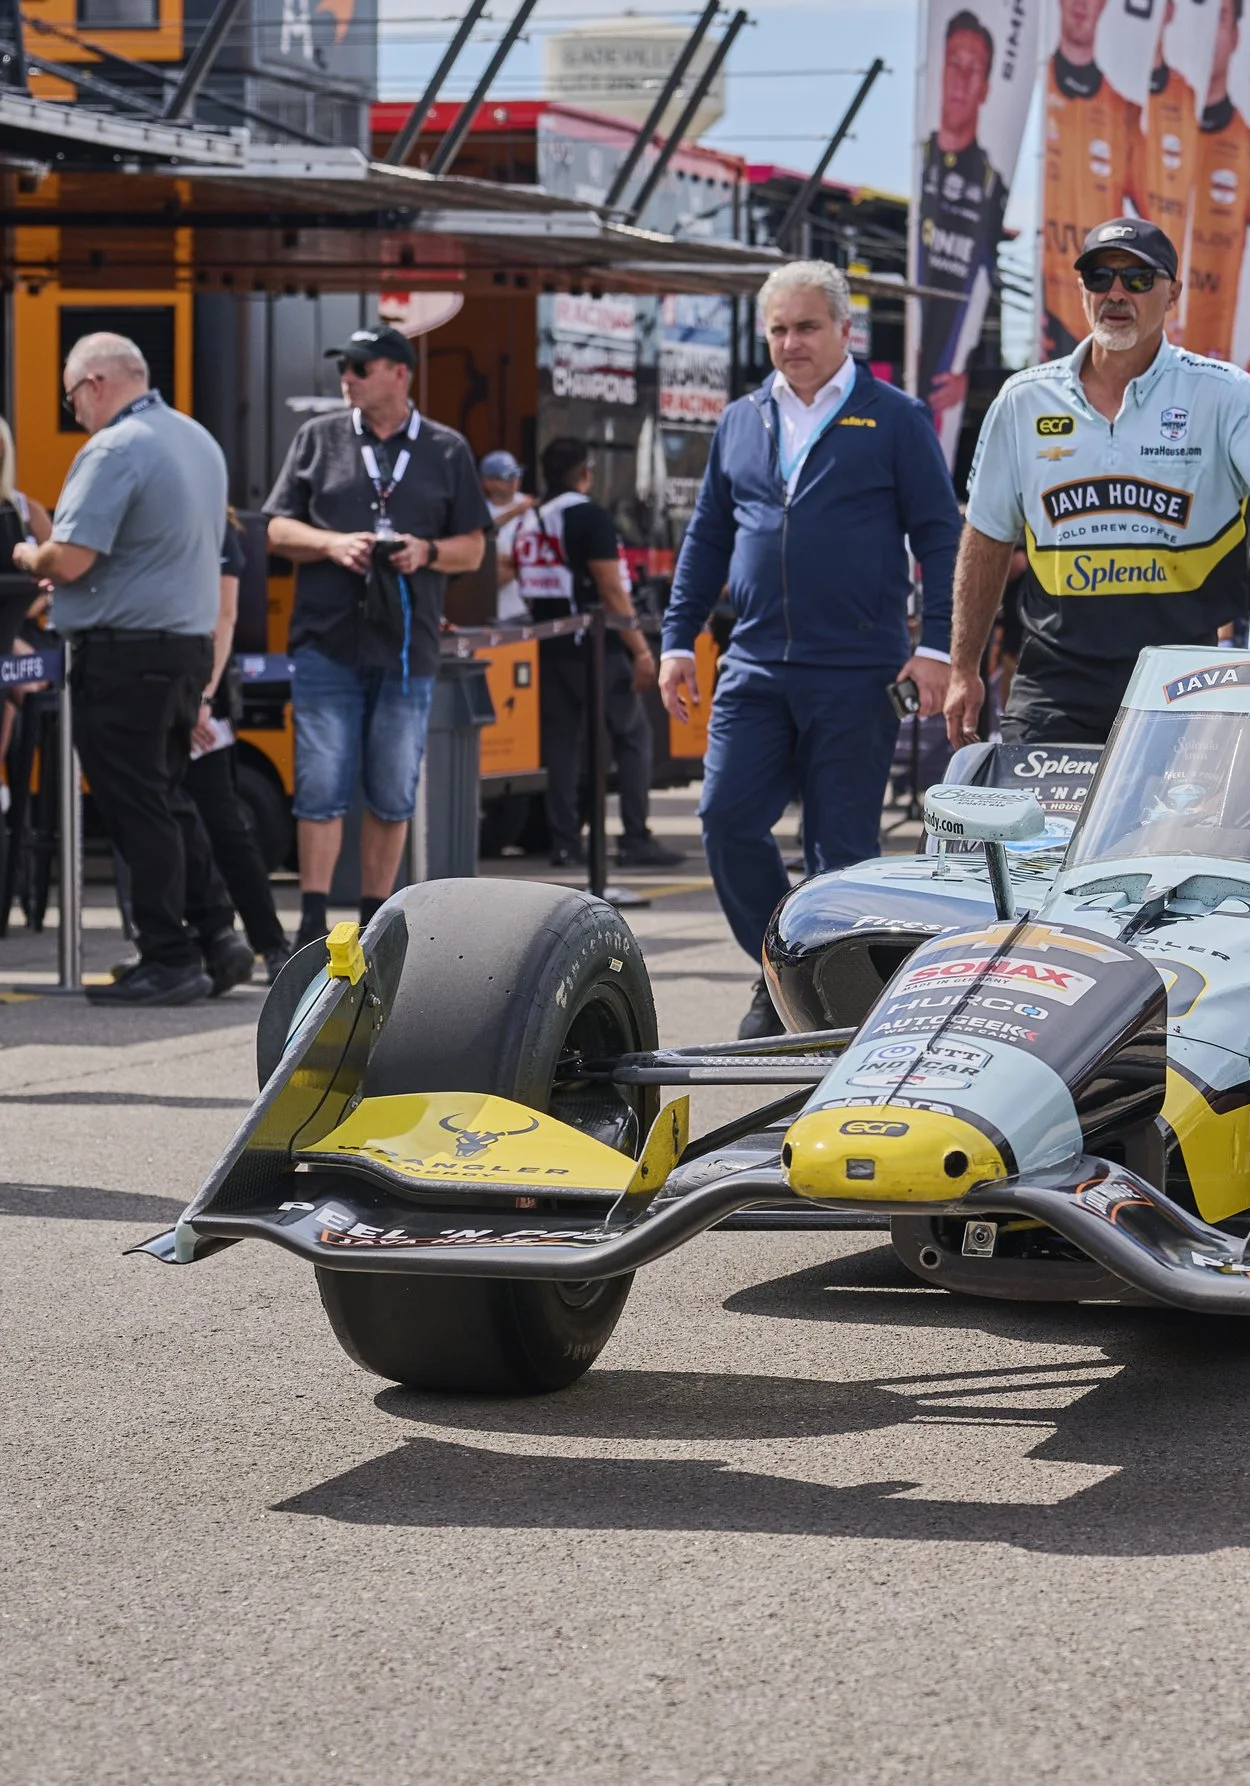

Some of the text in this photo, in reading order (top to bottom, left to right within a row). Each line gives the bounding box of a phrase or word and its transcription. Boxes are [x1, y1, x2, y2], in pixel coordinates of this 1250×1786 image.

[1039, 419, 1070, 434] ecr
[1050, 483, 1182, 519] JAVA HOUSE
[1057, 524, 1178, 544] COLD BREW COFFEE
[1066, 554, 1168, 592] Splenda
[1, 656, 44, 682] CLIFFS
[1176, 668, 1238, 696] JAVA
[901, 983, 932, 993] MADE
[886, 994, 1049, 1020] HURCO
[872, 1014, 1028, 1039] AUTOGEEK
[885, 1027, 907, 1035] WE
[978, 1028, 1018, 1043] CARE
[928, 1046, 982, 1062] NTT
[845, 1121, 904, 1135] ecr
[277, 1201, 409, 1239] PEEL
